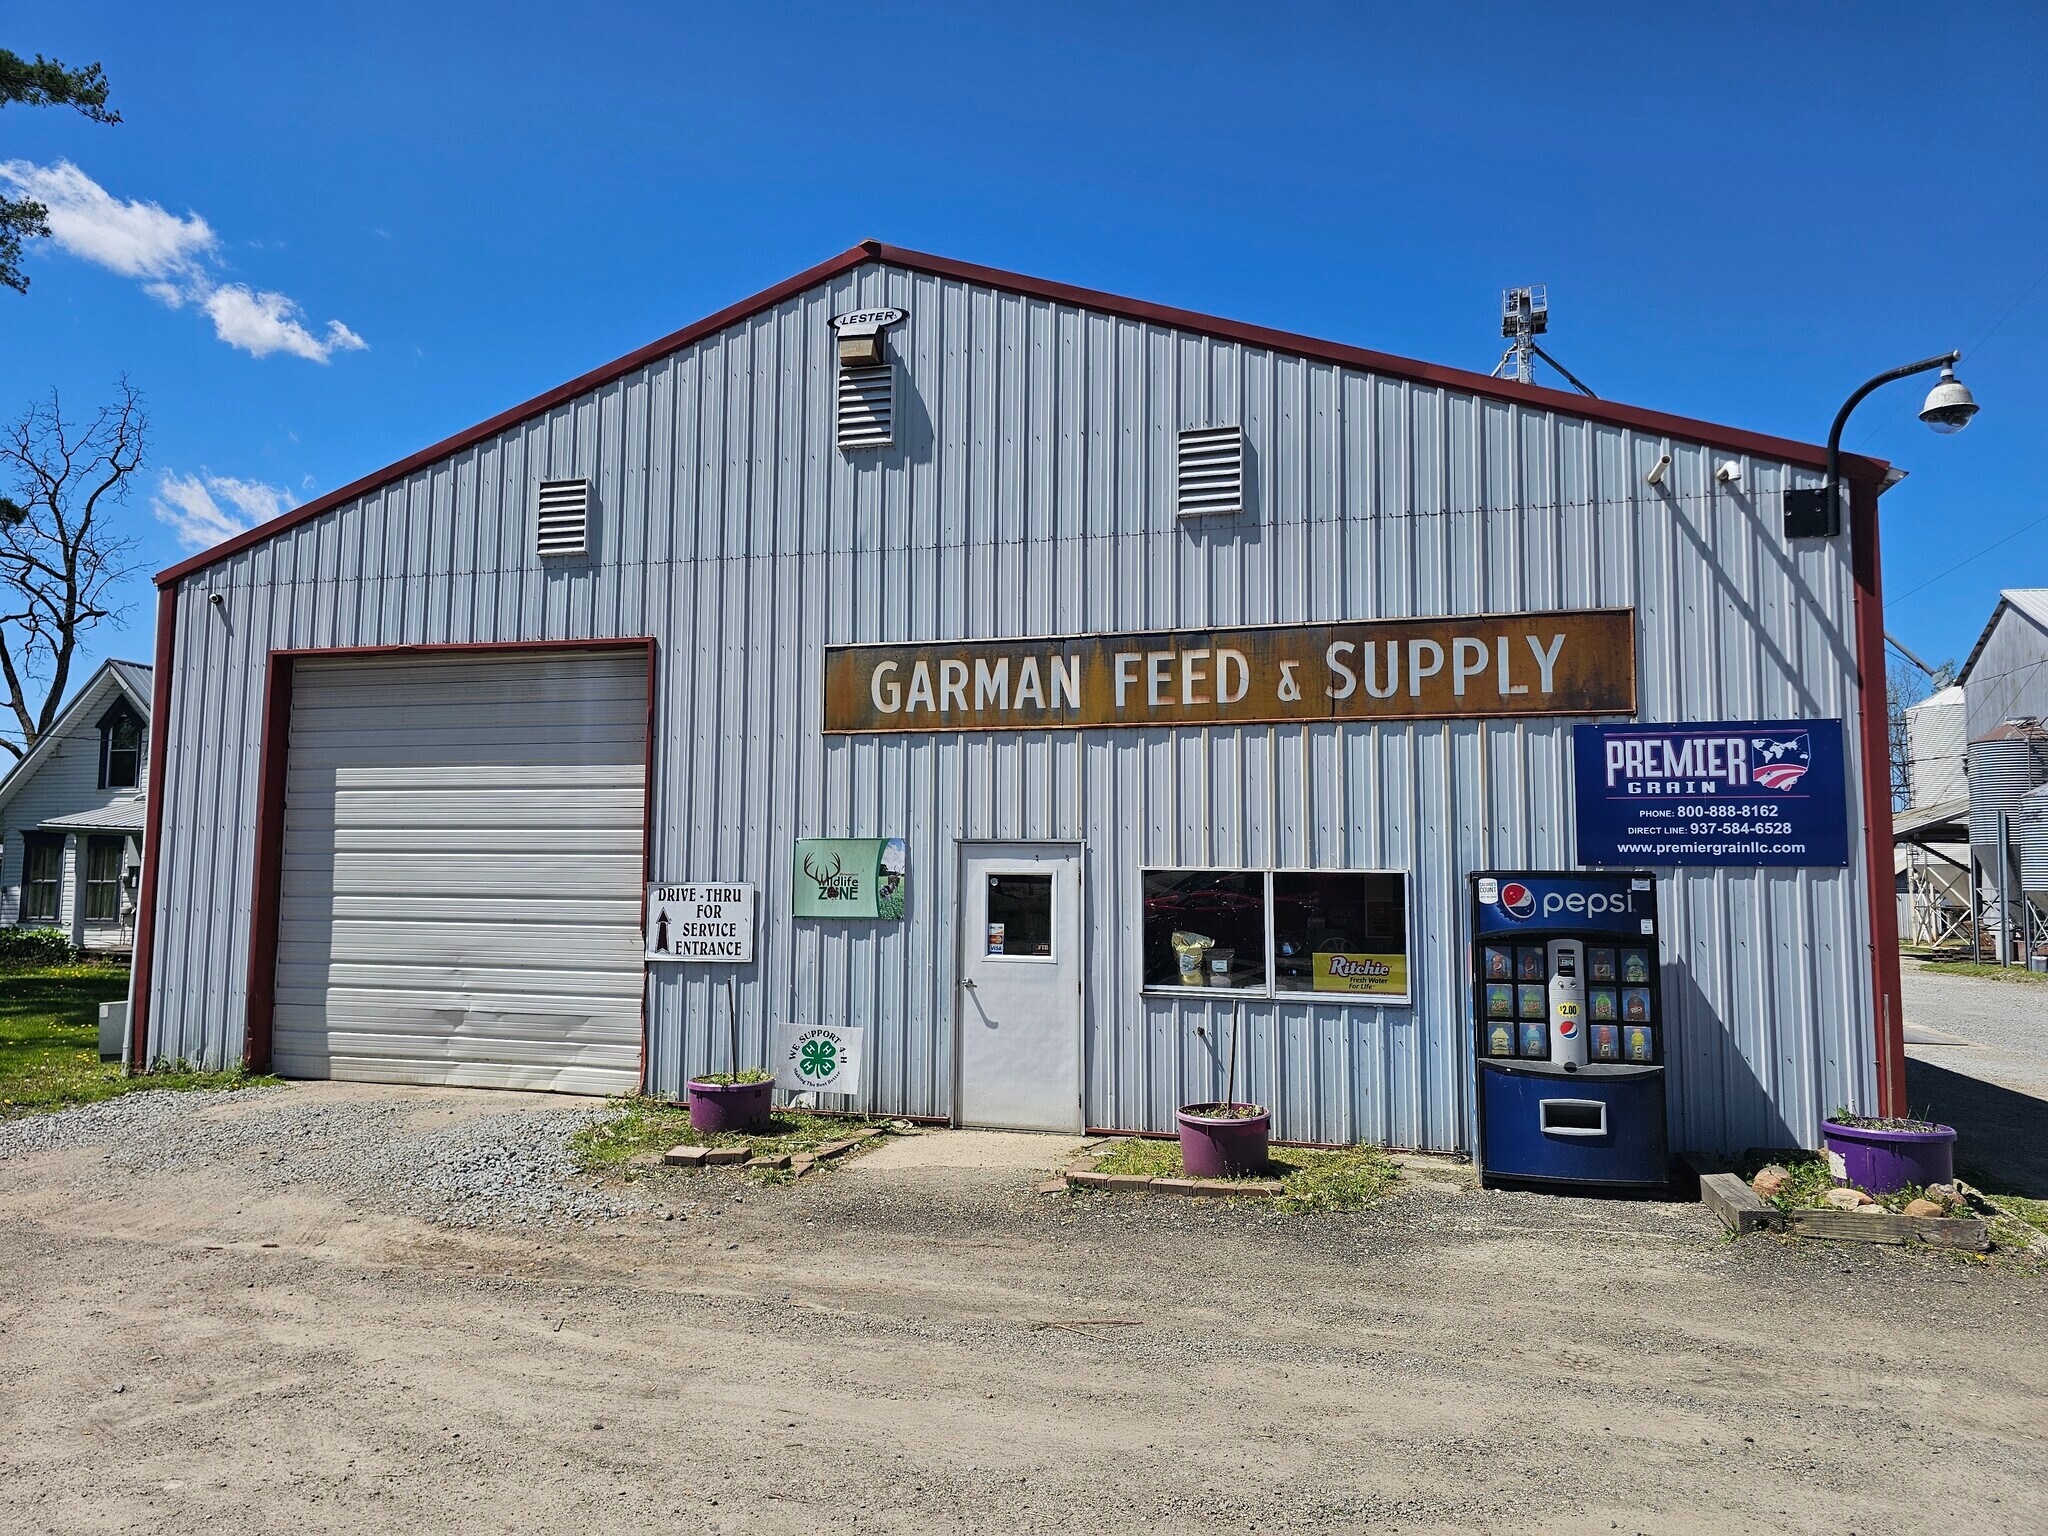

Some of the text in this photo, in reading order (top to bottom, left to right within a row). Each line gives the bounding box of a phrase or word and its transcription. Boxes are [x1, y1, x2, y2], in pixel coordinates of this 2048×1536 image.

[842, 311, 894, 325] LESTER
[871, 633, 1567, 713] GARMAN FEED & SUPPLY
[1606, 738, 1748, 787] PREMIER
[1627, 781, 1716, 794] GRAIN
[1639, 805, 1779, 818] PHONE: 800-888-8162
[1627, 822, 1792, 835] DIRECT LINE: 937-584-6528
[1617, 841, 1806, 856] www.premiergrainllc.com
[1543, 888, 1633, 919] pepsi
[696, 905, 722, 919] FOR
[682, 923, 737, 937] SERVICE
[675, 941, 742, 956] ENTRANCE
[1329, 955, 1390, 978] Ritchie
[789, 1029, 848, 1064] WE SUPPORT 4-H
[806, 1044, 832, 1055] H H
[803, 1061, 832, 1072] H H
[793, 1067, 806, 1085] Making
[828, 1071, 841, 1085] Better
